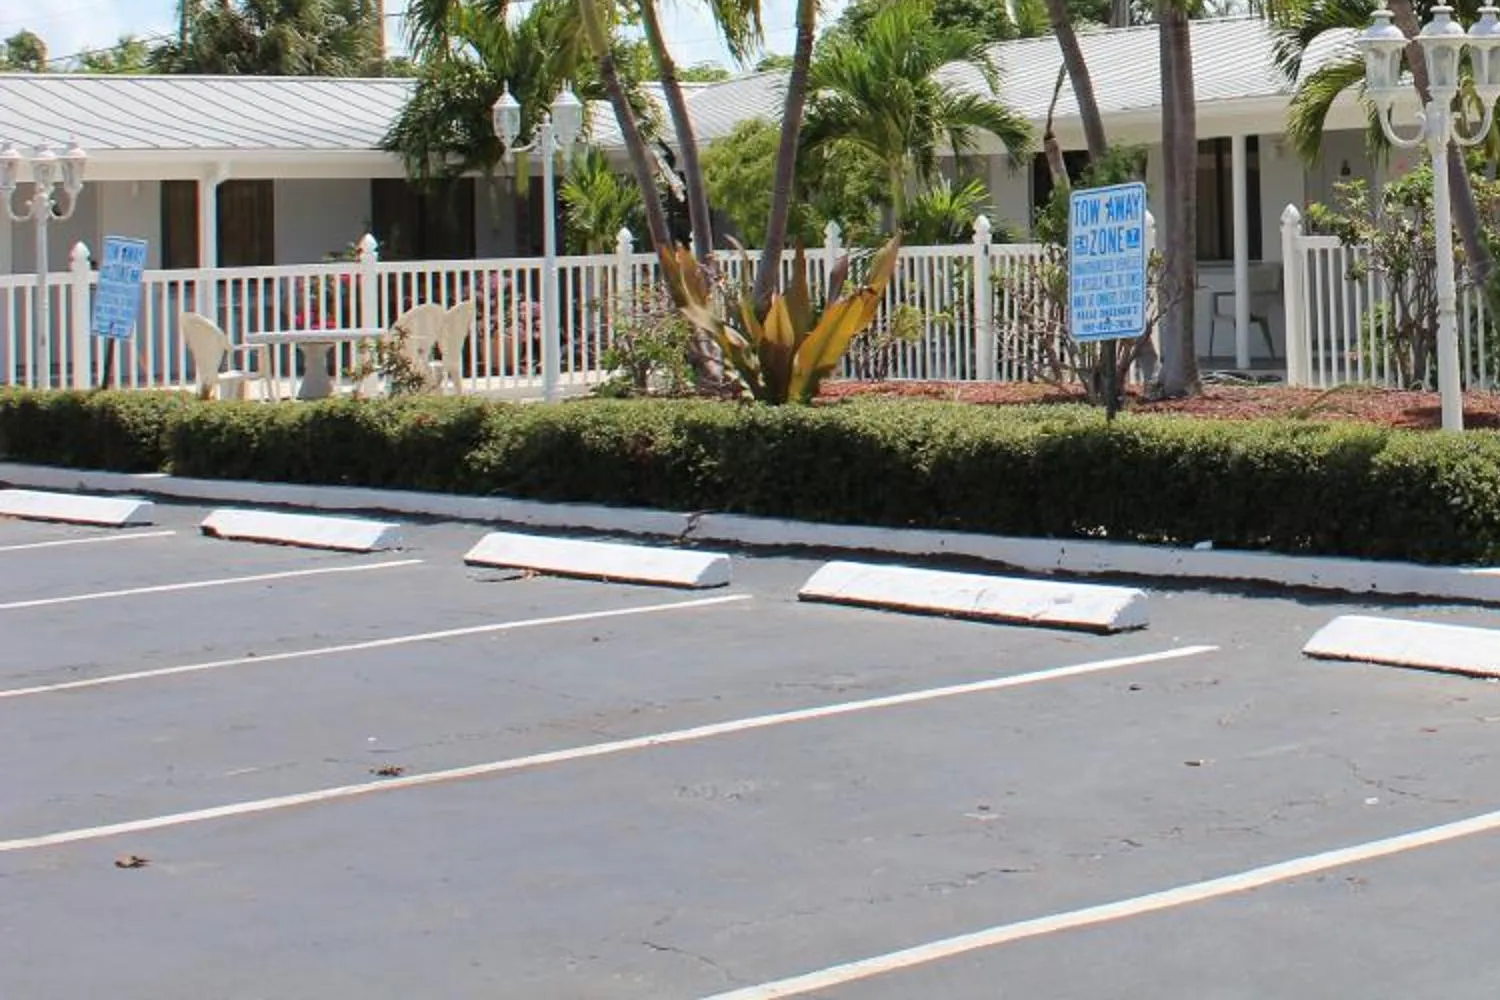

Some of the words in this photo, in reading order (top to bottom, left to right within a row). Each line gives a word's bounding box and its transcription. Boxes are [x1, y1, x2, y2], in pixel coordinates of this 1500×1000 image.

[1074, 199, 1100, 226] TOW
[1106, 193, 1140, 221] AWAY
[1089, 227, 1125, 256] ZONE
